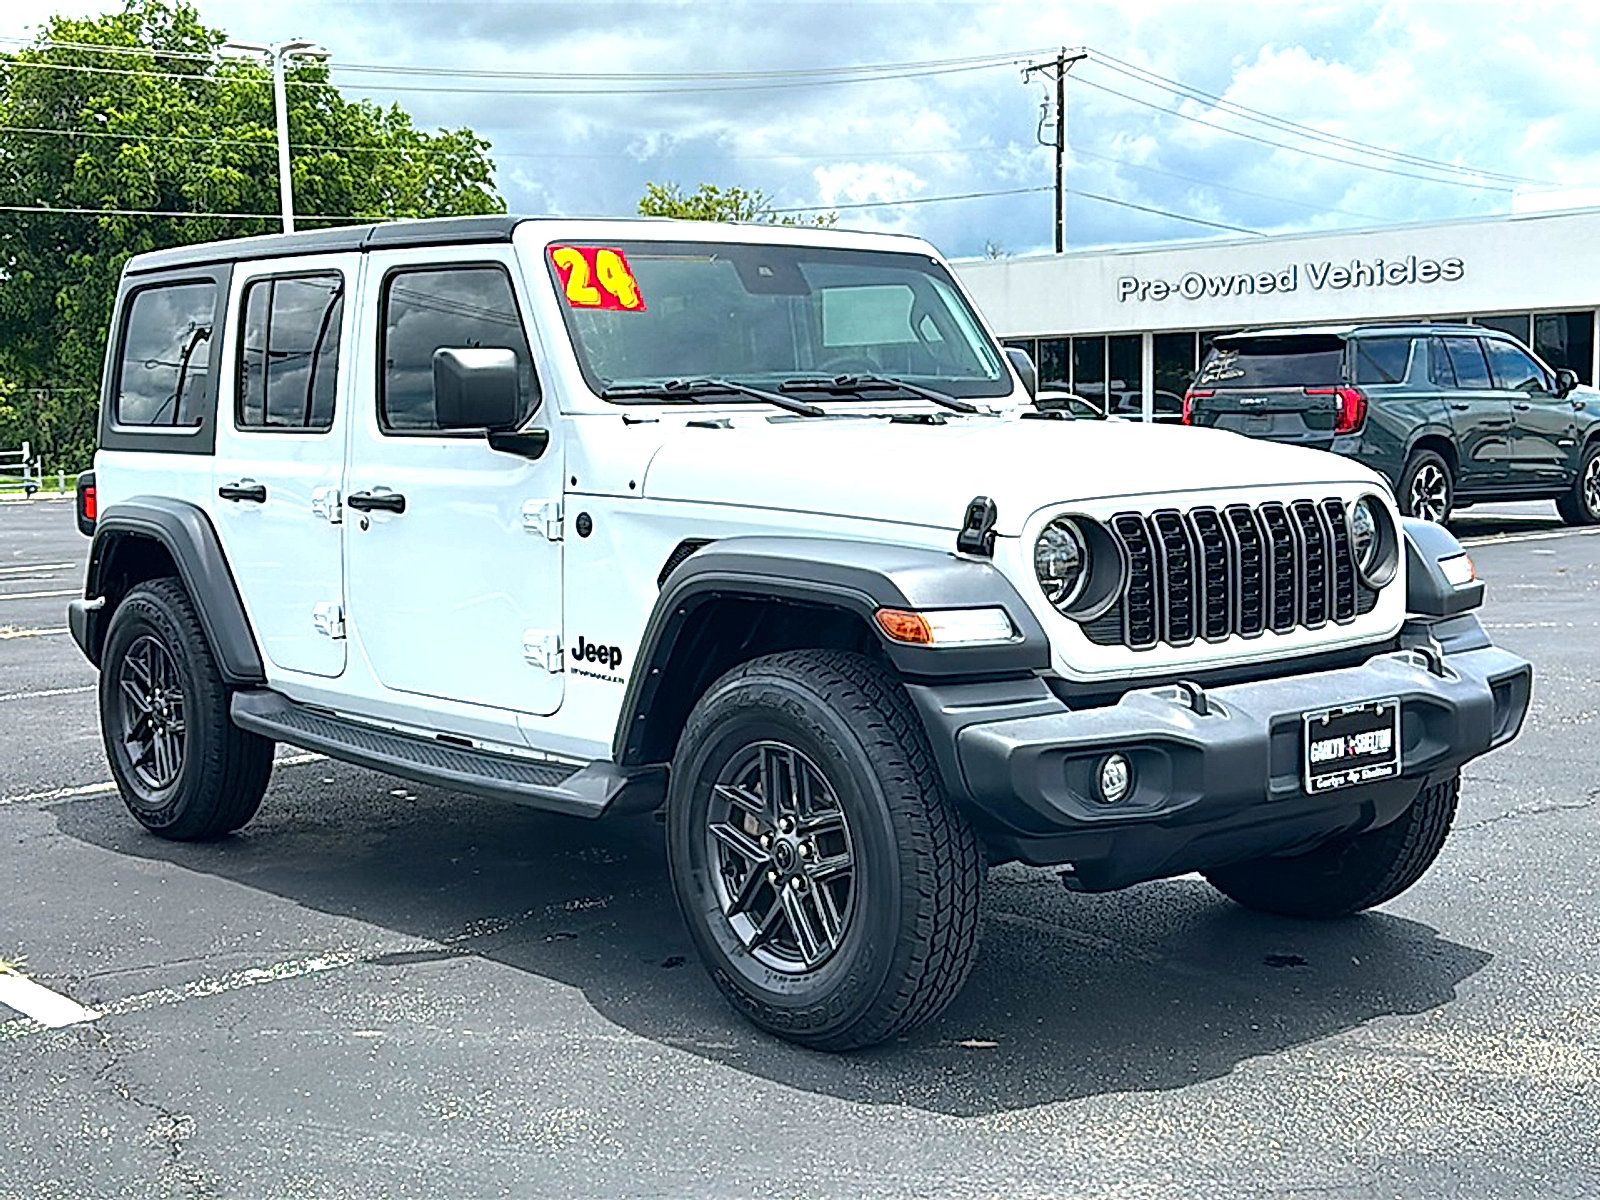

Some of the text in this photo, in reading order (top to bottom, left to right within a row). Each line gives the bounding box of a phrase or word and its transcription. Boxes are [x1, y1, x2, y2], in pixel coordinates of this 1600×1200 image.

[553, 247, 639, 308] 24
[1118, 255, 1465, 302] Pre-Owned Vehicles
[571, 636, 622, 670] Jeep
